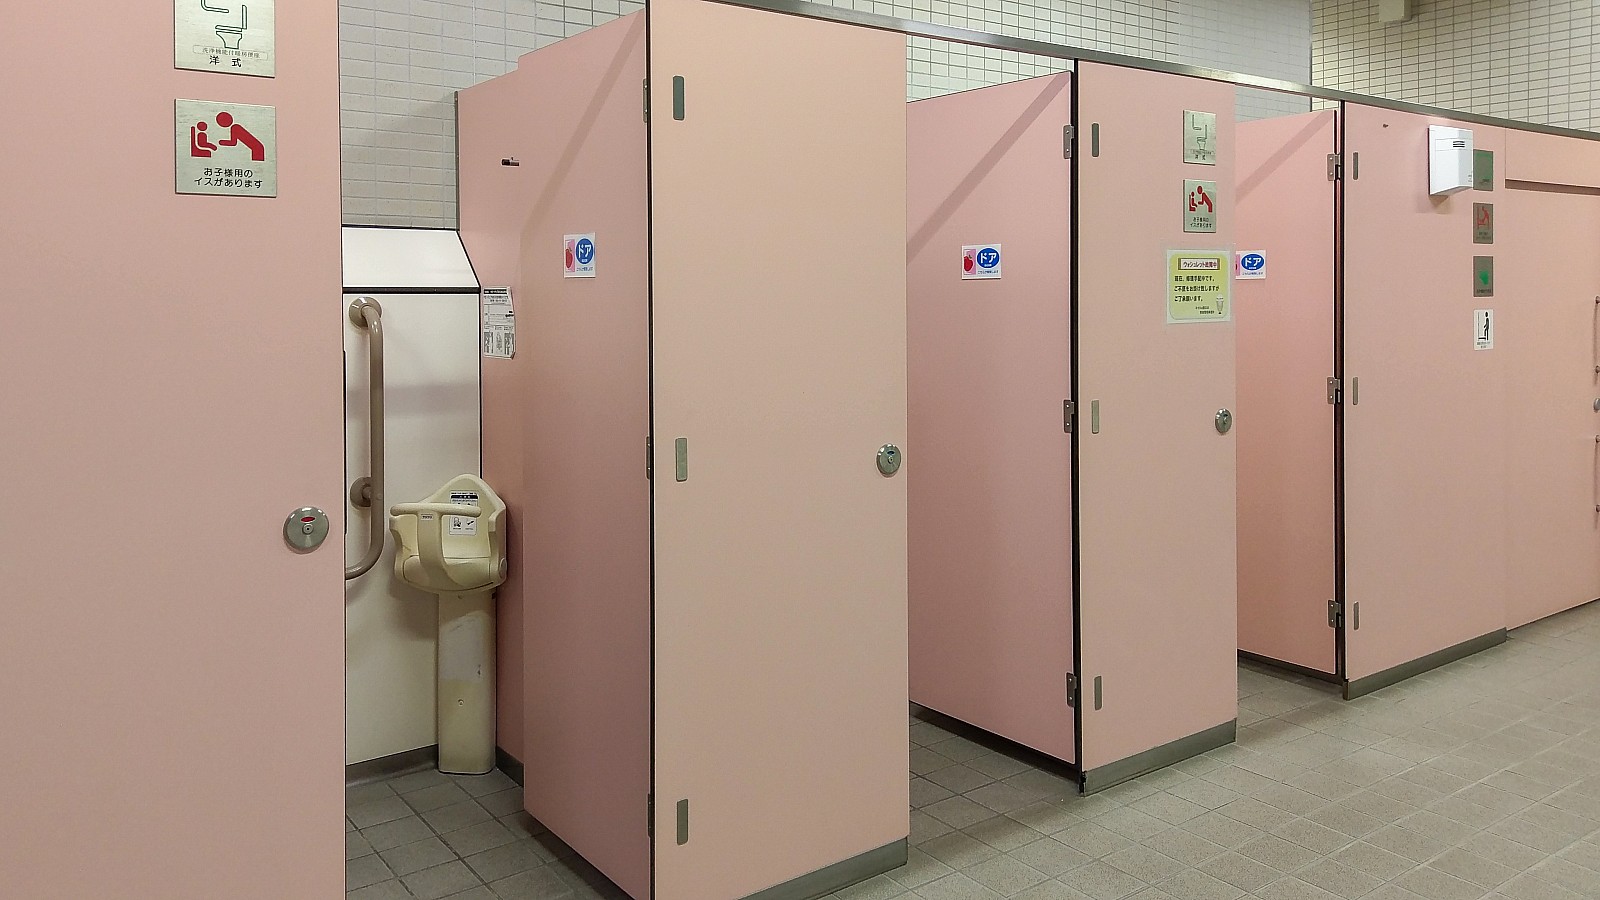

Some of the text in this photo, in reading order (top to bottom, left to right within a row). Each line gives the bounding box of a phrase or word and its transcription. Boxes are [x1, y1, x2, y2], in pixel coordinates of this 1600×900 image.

[203, 167, 253, 178] お子様用の
[194, 177, 263, 188] イスがあります
[578, 243, 592, 259] ドア
[980, 252, 997, 264] ドア
[1244, 257, 1262, 267] ドア
